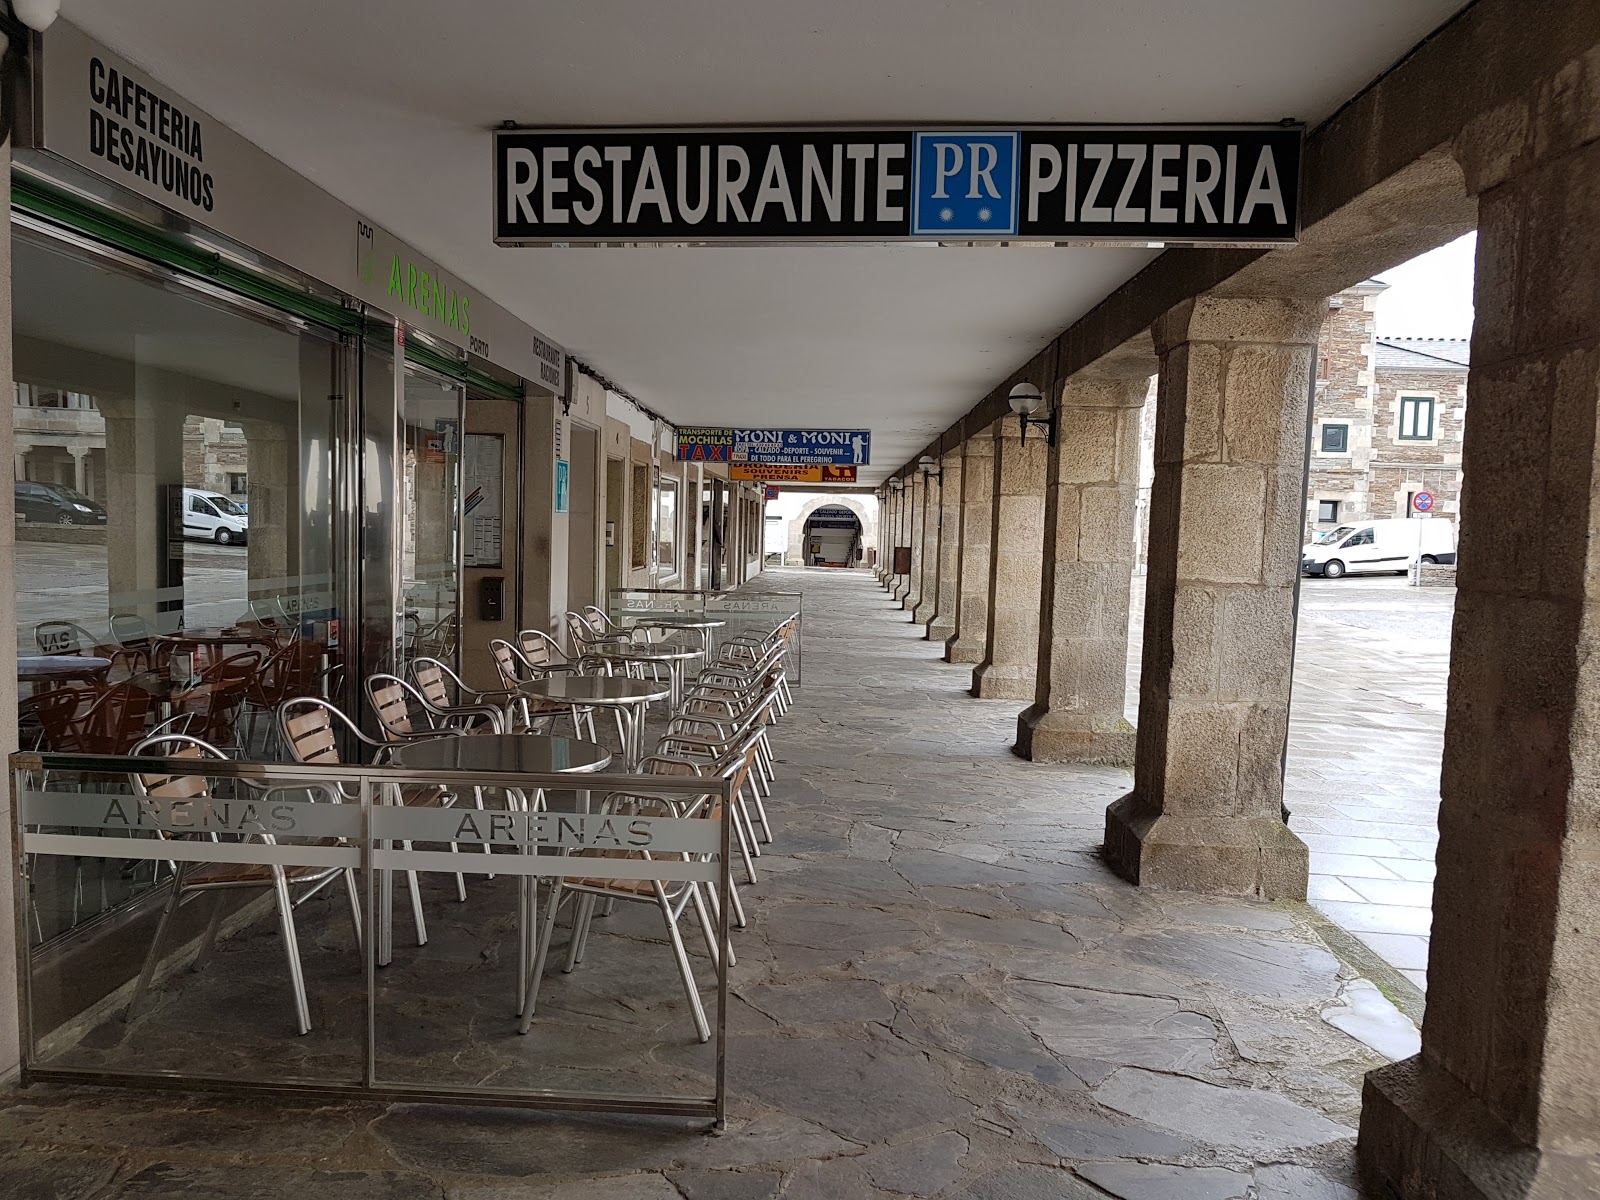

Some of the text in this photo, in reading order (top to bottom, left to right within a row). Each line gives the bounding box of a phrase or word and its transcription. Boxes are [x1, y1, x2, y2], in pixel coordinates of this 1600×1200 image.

[89, 57, 203, 163] CAFETERIA
[89, 109, 214, 212] DESAYUNOS
[506, 142, 1288, 225] RESTAURANTE PR PIZZERIA
[387, 254, 470, 335] ARENAS
[470, 335, 489, 358] PORTO
[532, 335, 560, 368] RESTAURANTE
[679, 436, 733, 445] MOCHILAS
[734, 430, 851, 444] MONI & MONI
[679, 444, 733, 461] TAXI
[800, 456, 833, 464] PEREGRINO
[814, 448, 844, 456] SOUVENIR
[103, 799, 654, 846] ARENAS ARENAS
